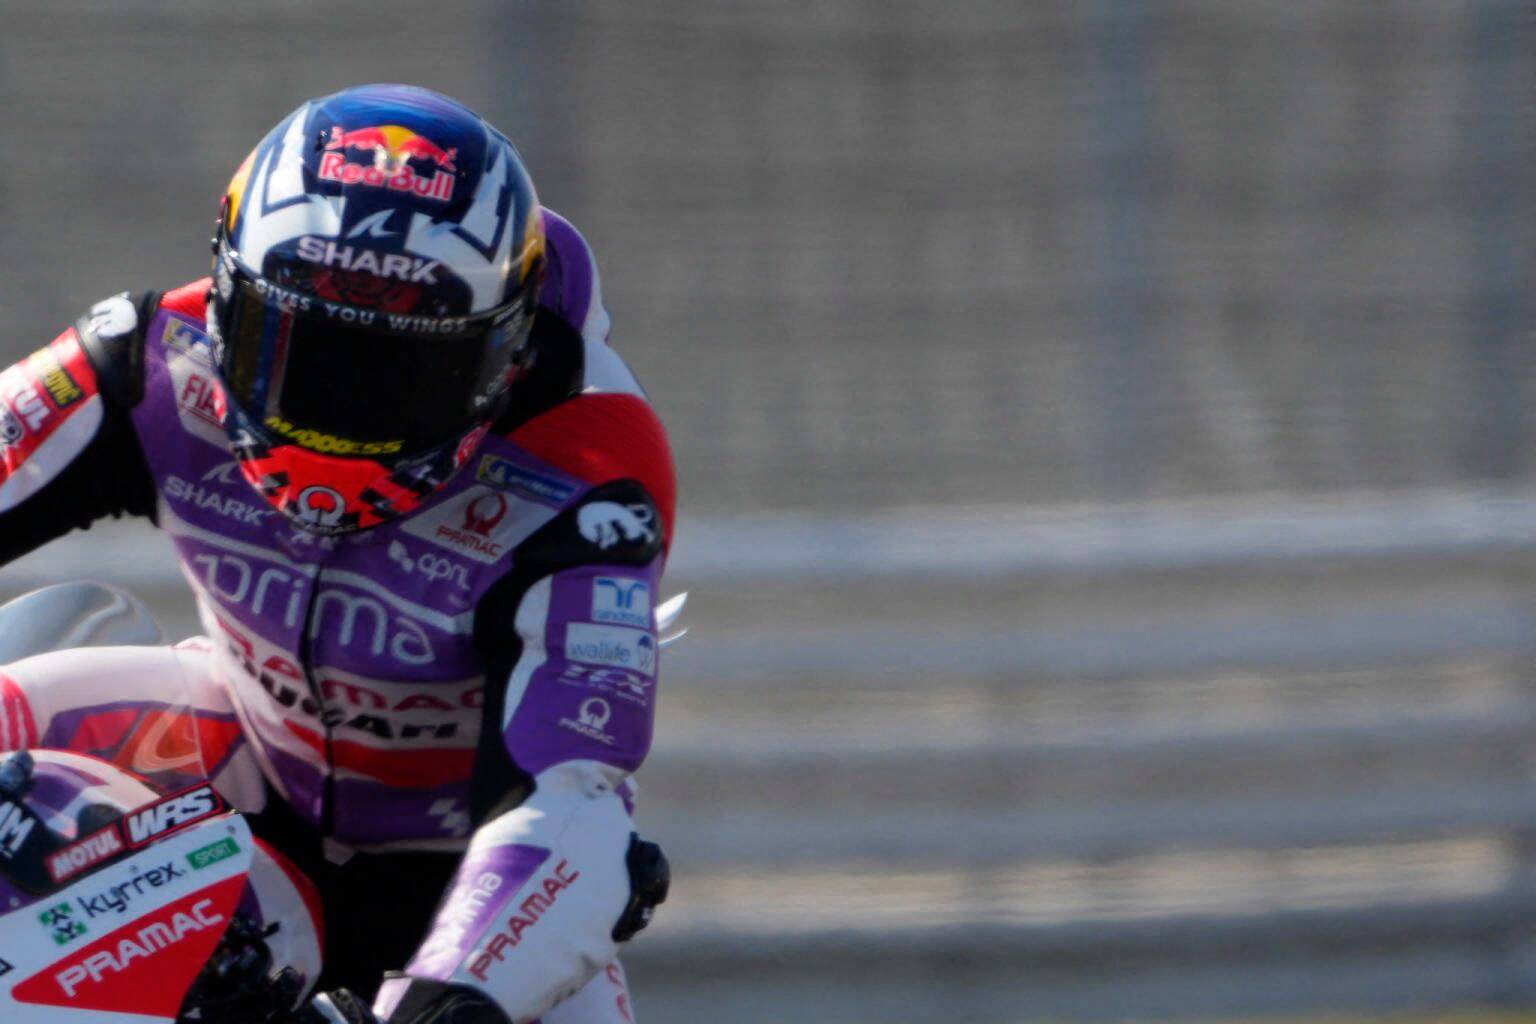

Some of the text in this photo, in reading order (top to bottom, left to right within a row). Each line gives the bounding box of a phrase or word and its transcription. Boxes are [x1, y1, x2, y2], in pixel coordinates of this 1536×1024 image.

[318, 152, 455, 202] Red Bull
[296, 235, 441, 286] SHARK
[255, 279, 311, 312] GIVES
[325, 304, 375, 325] YOU
[388, 313, 467, 335] WINGS
[182, 373, 218, 414] FIA
[166, 475, 263, 527] SHARK
[195, 553, 435, 665] prima
[127, 788, 215, 843] WRS
[51, 831, 121, 881] MOTUL
[194, 842, 233, 866] SPORT
[469, 860, 579, 981] PRAMAC
[57, 899, 226, 998] PRAMAC
